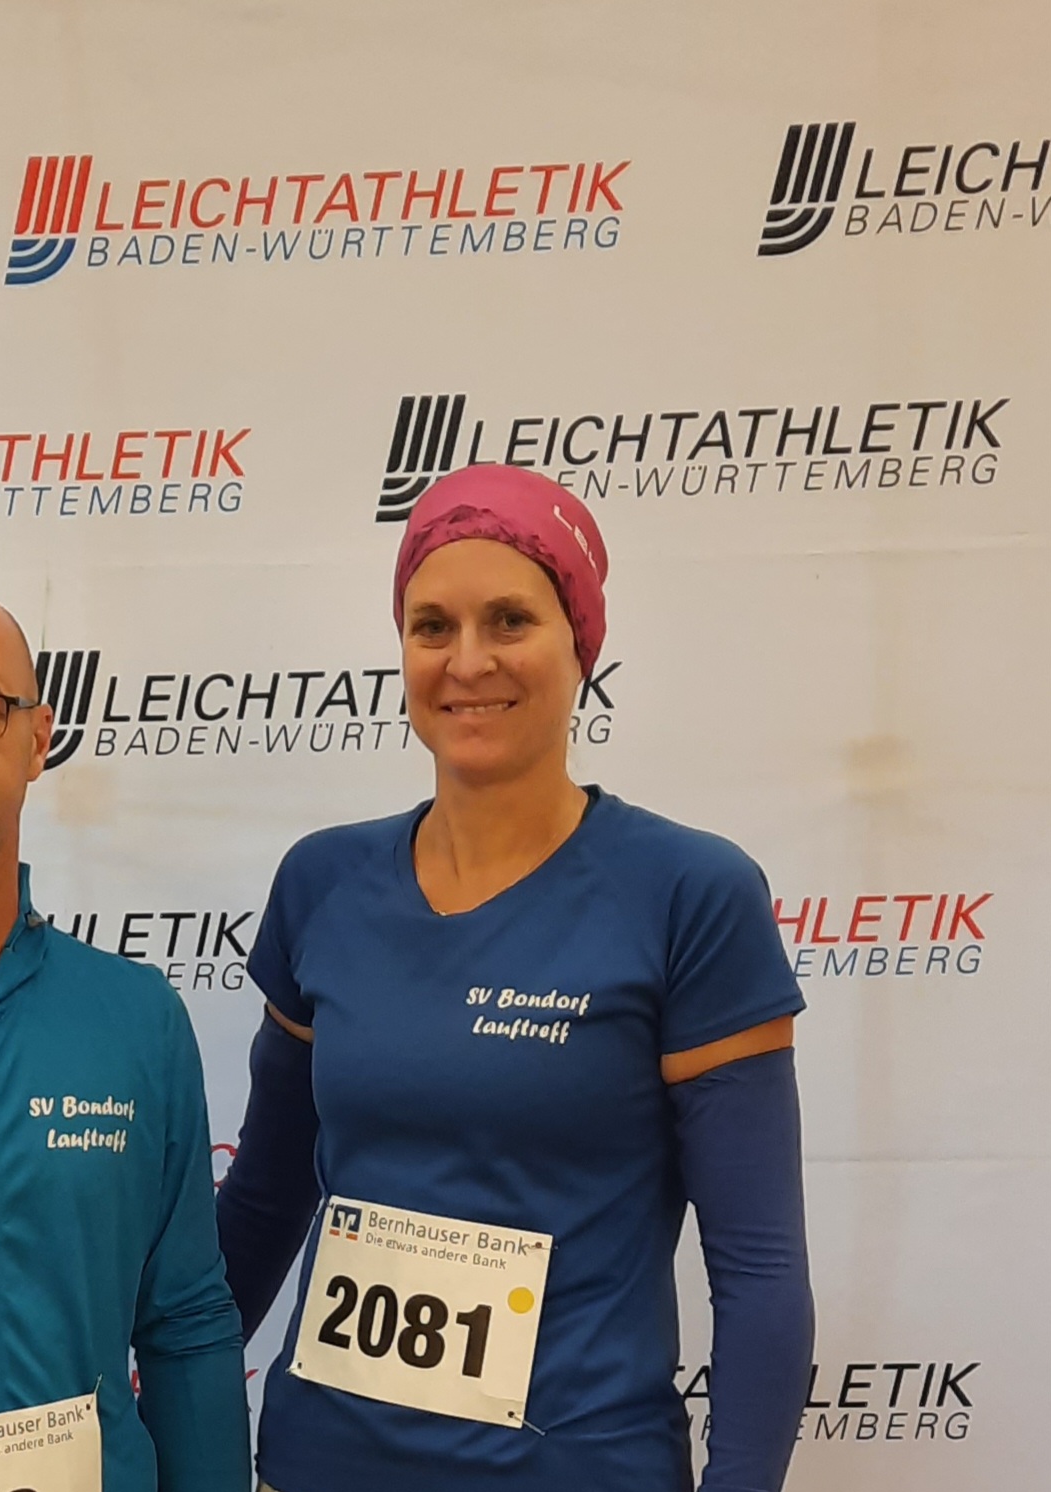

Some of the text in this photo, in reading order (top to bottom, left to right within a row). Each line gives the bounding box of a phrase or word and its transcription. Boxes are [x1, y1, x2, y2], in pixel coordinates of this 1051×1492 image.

[94, 159, 633, 233] LEICHTATHLETIK
[86, 216, 622, 268] BADEN-WÜRTTEMBERG
[467, 397, 1012, 467] LEICHTATHLETIK
[465, 986, 591, 1017] SV Bondorf
[471, 1014, 571, 1045] Lauftreff
[28, 1095, 135, 1122] SV Bondorf
[46, 1128, 127, 1153] Lauftreff
[367, 1210, 529, 1256] Bernhauser Bank
[364, 1231, 508, 1271] Die etwas andere Bank
[317, 1274, 493, 1379] 2081
[46, 1405, 86, 1429] Bank
[3, 1437, 45, 1454] andere
[46, 1429, 74, 1445] Bank
